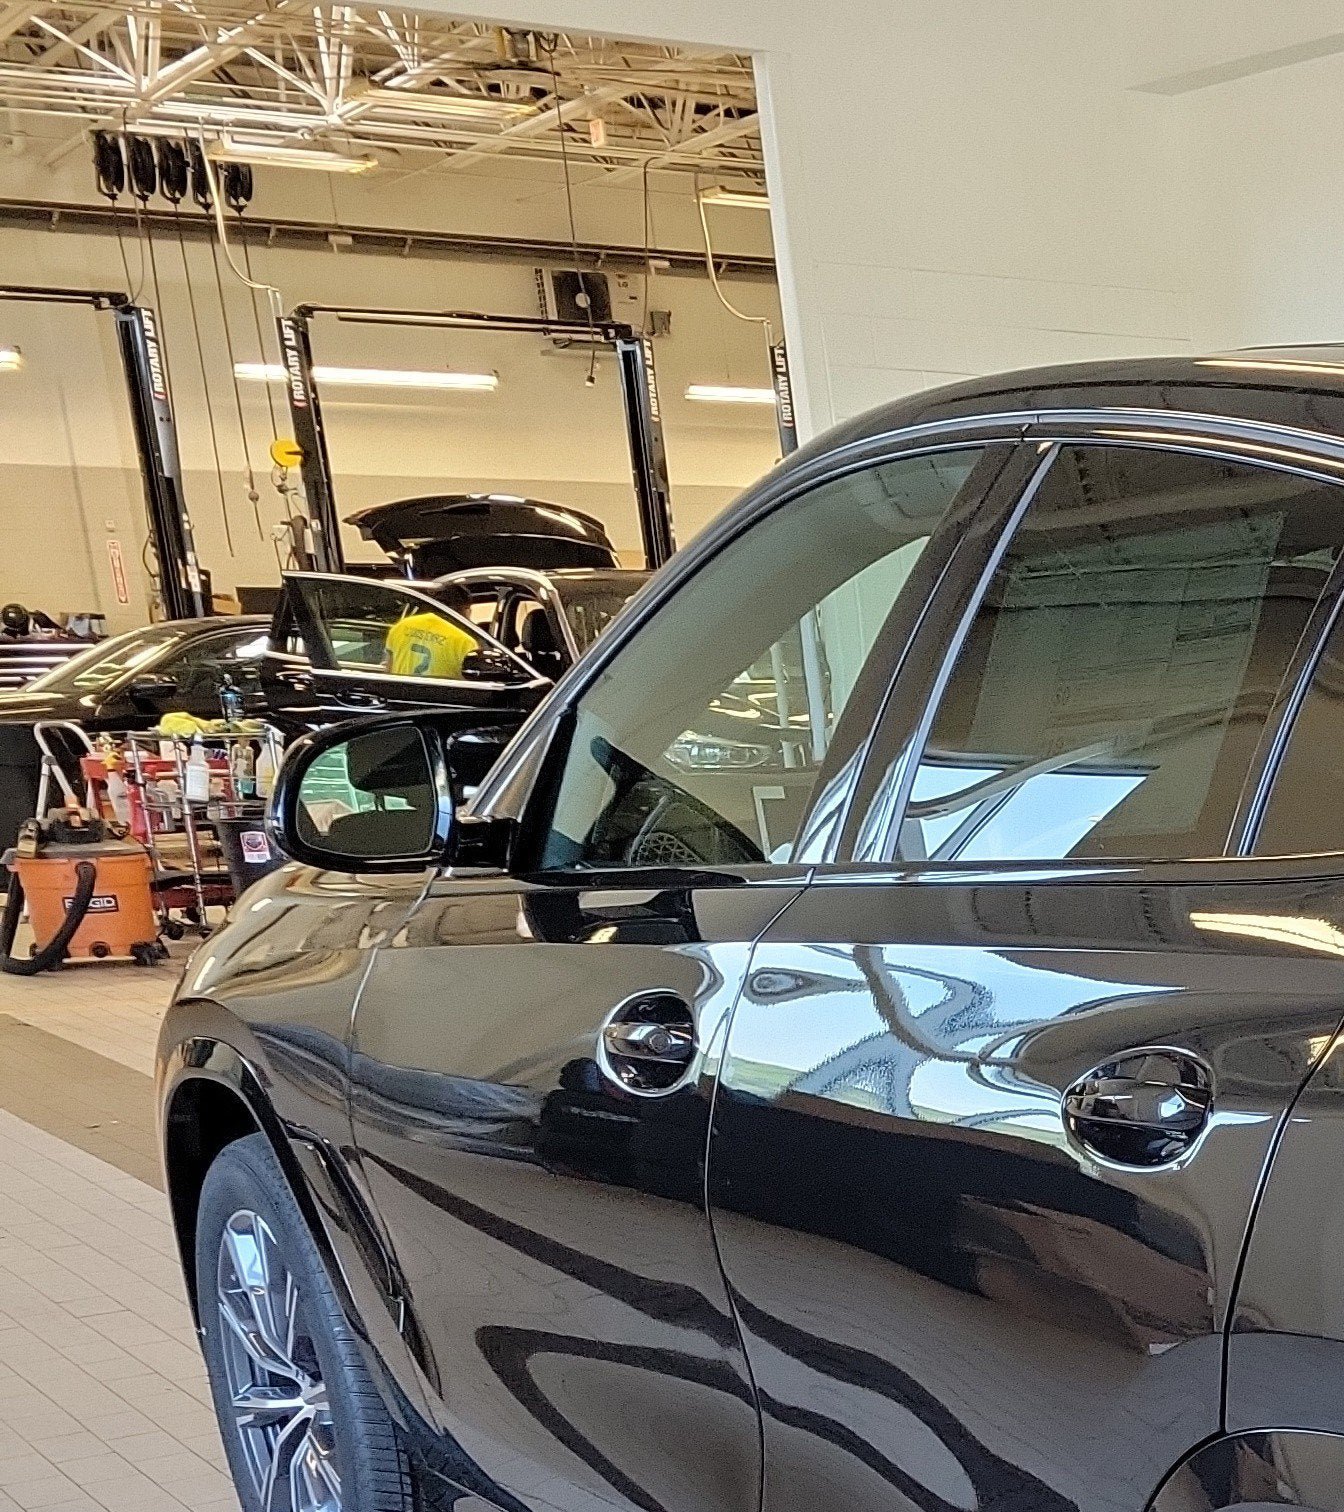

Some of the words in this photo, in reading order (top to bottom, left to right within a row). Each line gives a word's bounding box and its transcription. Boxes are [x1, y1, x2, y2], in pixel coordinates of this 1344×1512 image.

[141, 308, 156, 338] LIFT
[280, 318, 295, 346] LIFT
[147, 340, 166, 393] ROTARY
[286, 347, 305, 400] ROTARY
[773, 348, 786, 373] LIFT
[777, 374, 793, 421] ROTARY
[64, 897, 116, 909] RGID
